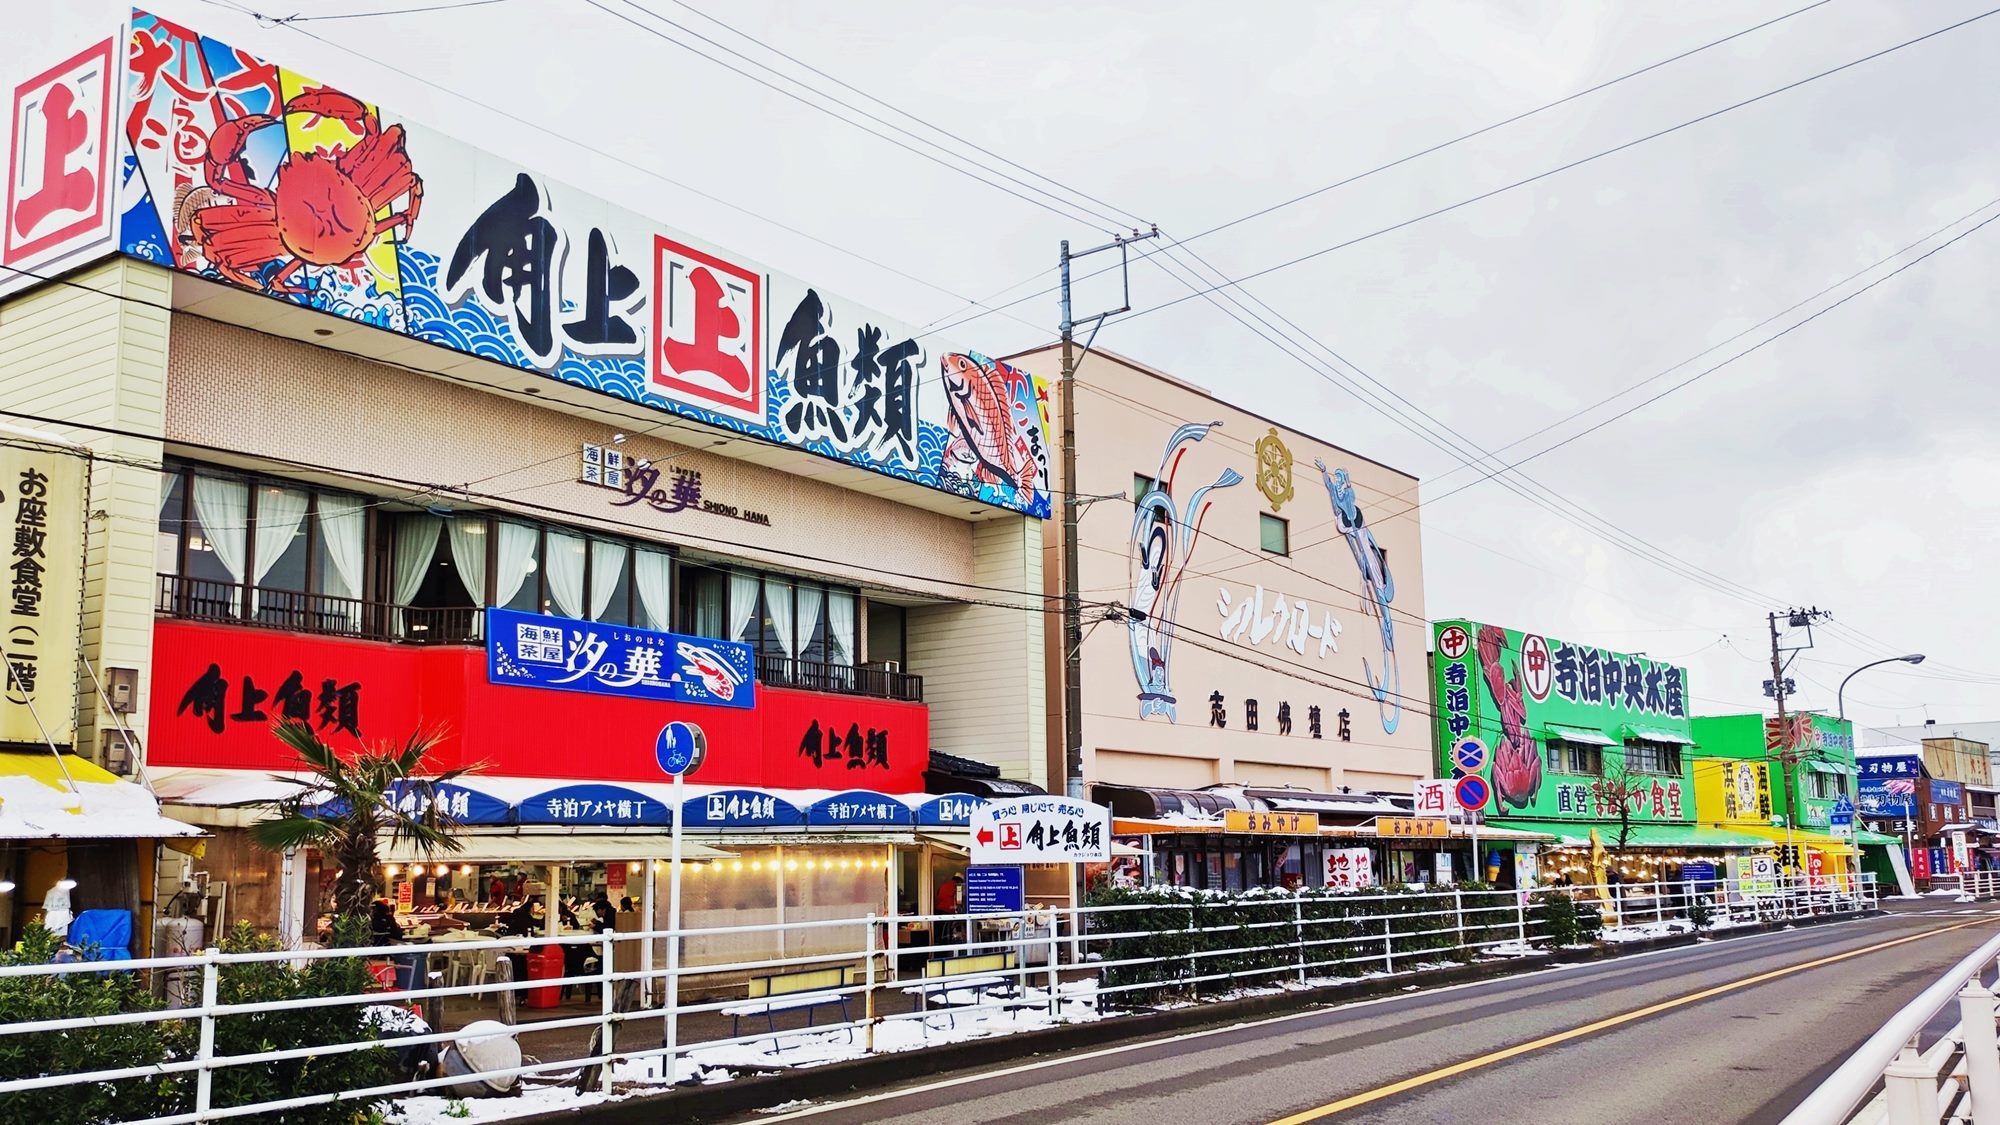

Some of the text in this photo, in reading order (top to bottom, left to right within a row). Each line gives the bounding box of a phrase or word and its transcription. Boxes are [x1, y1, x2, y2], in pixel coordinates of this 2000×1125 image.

[16, 82, 95, 238] 上
[586, 446, 620, 466] 海鮮
[585, 465, 620, 487] 茶屋
[703, 500, 770, 525] SHIONO HANA
[1216, 584, 1343, 659] シルクロード
[520, 626, 562, 643] 海鮮
[613, 631, 665, 647] しおのはな
[520, 644, 562, 662] 茶屋
[546, 630, 663, 688] 汐の華
[1418, 783, 1445, 812] 酒
[1557, 784, 1587, 814] 直営
[546, 798, 647, 820] 寺泊アメヤ横丁
[827, 802, 897, 821] 寺泊アメヤ横丁
[1248, 815, 1300, 832] おみやげ
[1394, 820, 1434, 835] おみやげ
[1002, 819, 1102, 852] 上 角上魚類
